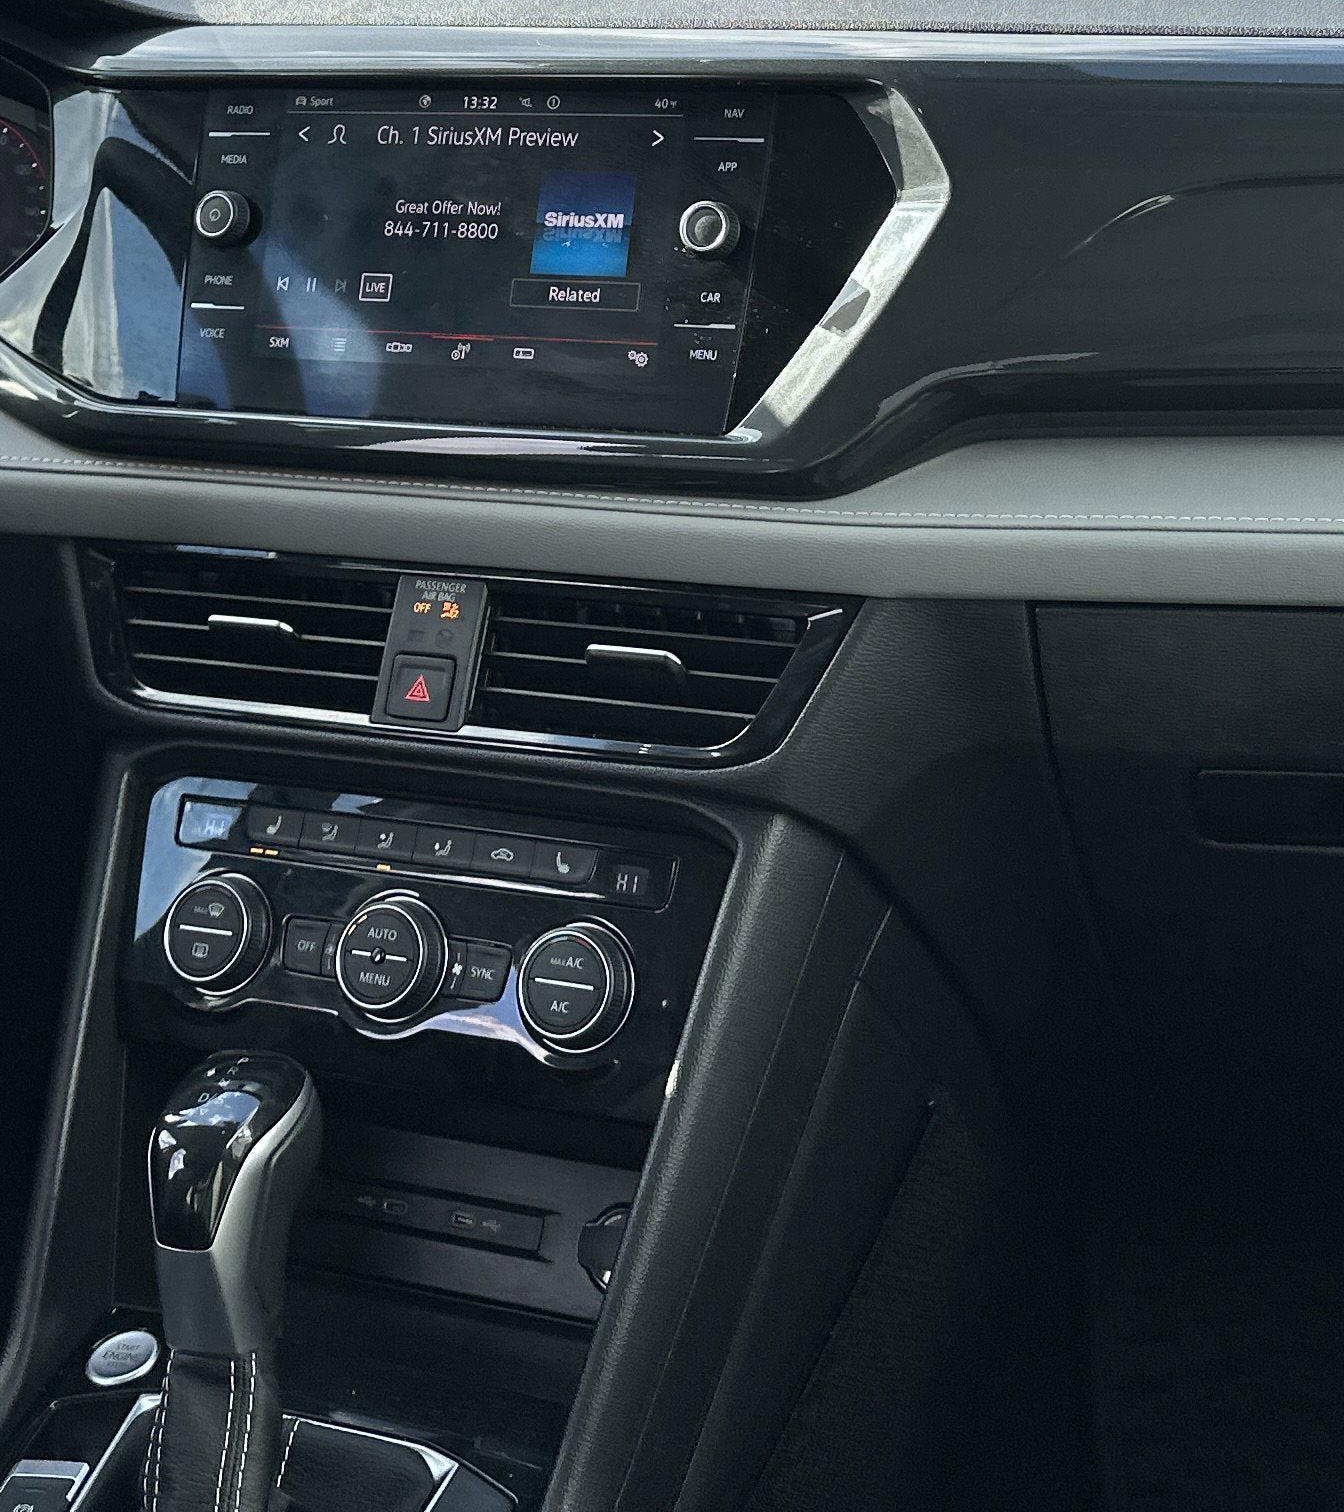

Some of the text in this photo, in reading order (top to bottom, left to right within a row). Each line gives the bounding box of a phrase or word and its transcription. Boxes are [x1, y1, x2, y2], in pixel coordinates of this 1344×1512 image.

[309, 96, 334, 107] Sport
[462, 96, 498, 110] 13:32
[226, 105, 254, 115] RADIO
[724, 108, 745, 119] NAV
[377, 125, 579, 147] Ch. 1 SiriusXM Preview
[220, 154, 248, 165] MEDIA
[717, 161, 738, 172] APP
[395, 199, 502, 216] Great Offer Now!
[544, 211, 625, 229] SiriusXM
[384, 220, 499, 239] 844-711-8800
[204, 275, 233, 286] PHONE
[365, 282, 386, 293] LIVE
[548, 286, 601, 303] Related
[700, 292, 721, 303] CAR
[200, 327, 226, 339] VOICE
[269, 337, 290, 348] SXM
[689, 350, 718, 361] MENU
[415, 579, 467, 593] PASSENGER
[413, 601, 432, 614] OFF
[367, 926, 399, 942] AUTO
[296, 939, 317, 952] OFF
[358, 971, 392, 987] MENU
[471, 968, 497, 981] SYNC
[549, 999, 570, 1014] A/C
